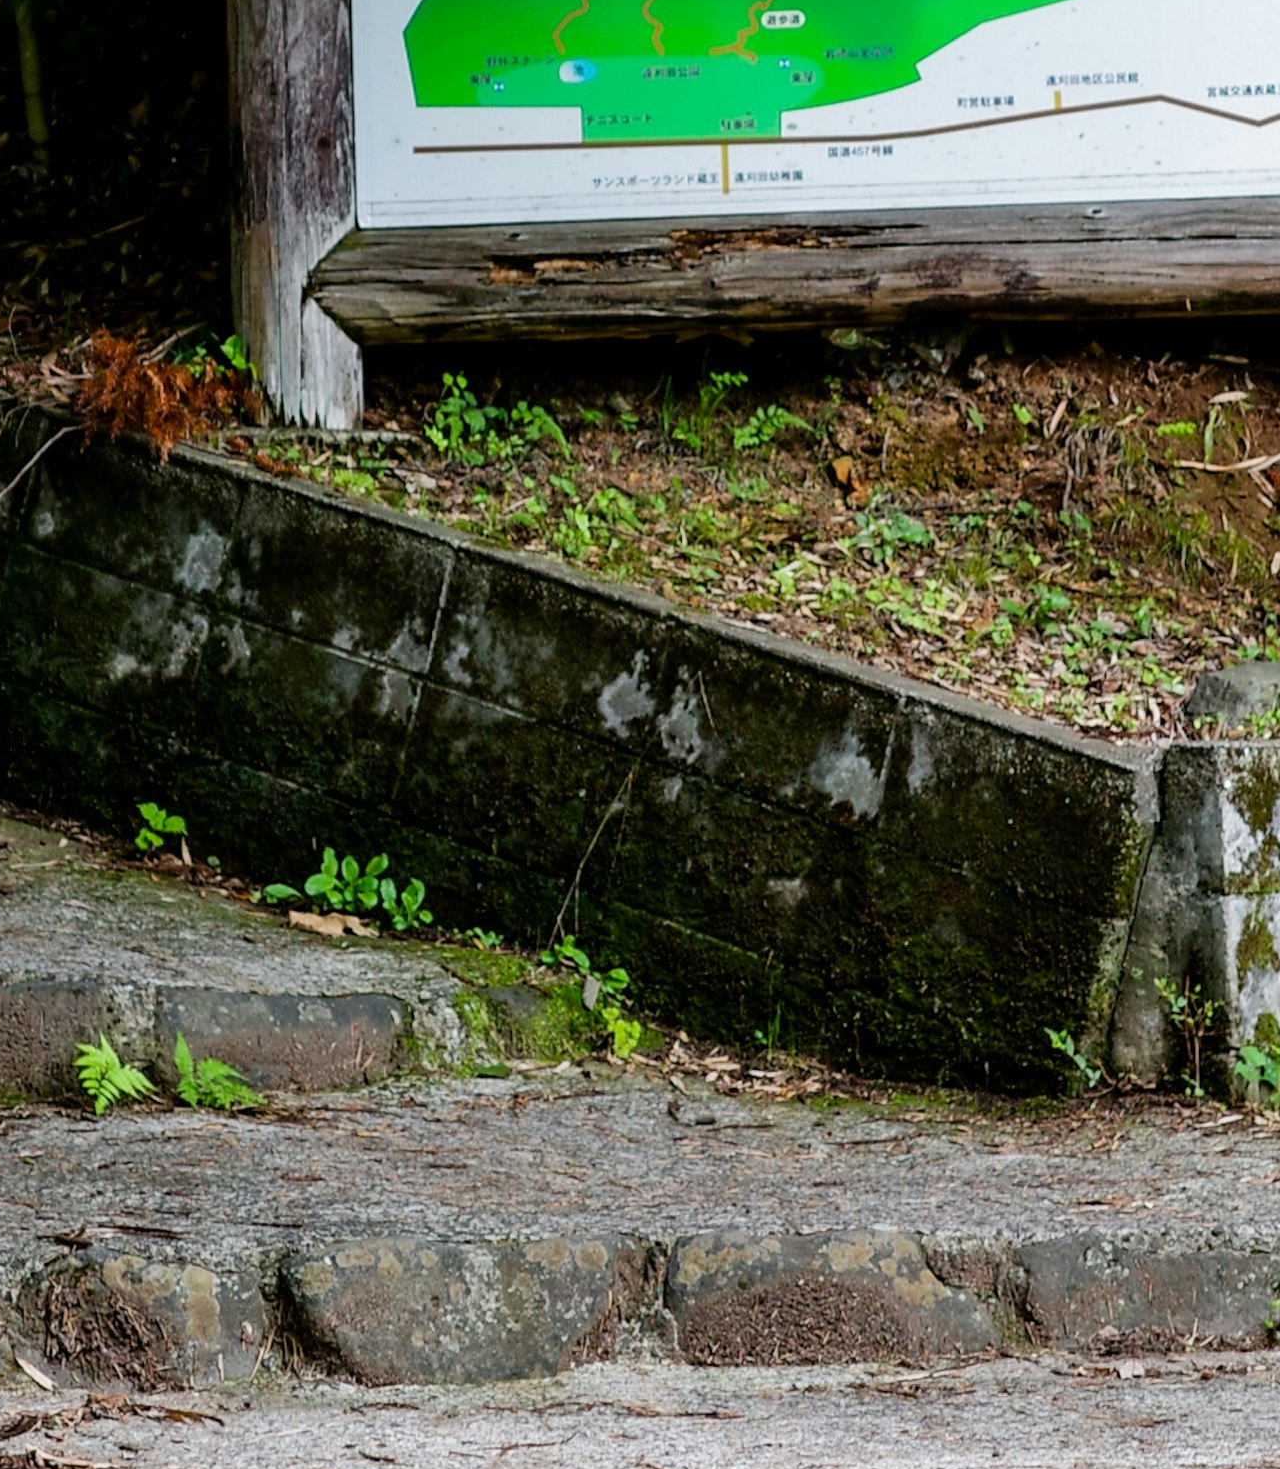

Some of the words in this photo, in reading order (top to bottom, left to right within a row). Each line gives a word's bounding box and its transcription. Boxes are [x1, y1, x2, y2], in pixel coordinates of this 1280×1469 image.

[766, 13, 801, 26] 遊歩道
[1046, 72, 1139, 87] 遠刈田地区公民館
[593, 172, 718, 189] サンスポーツランド蔵王
